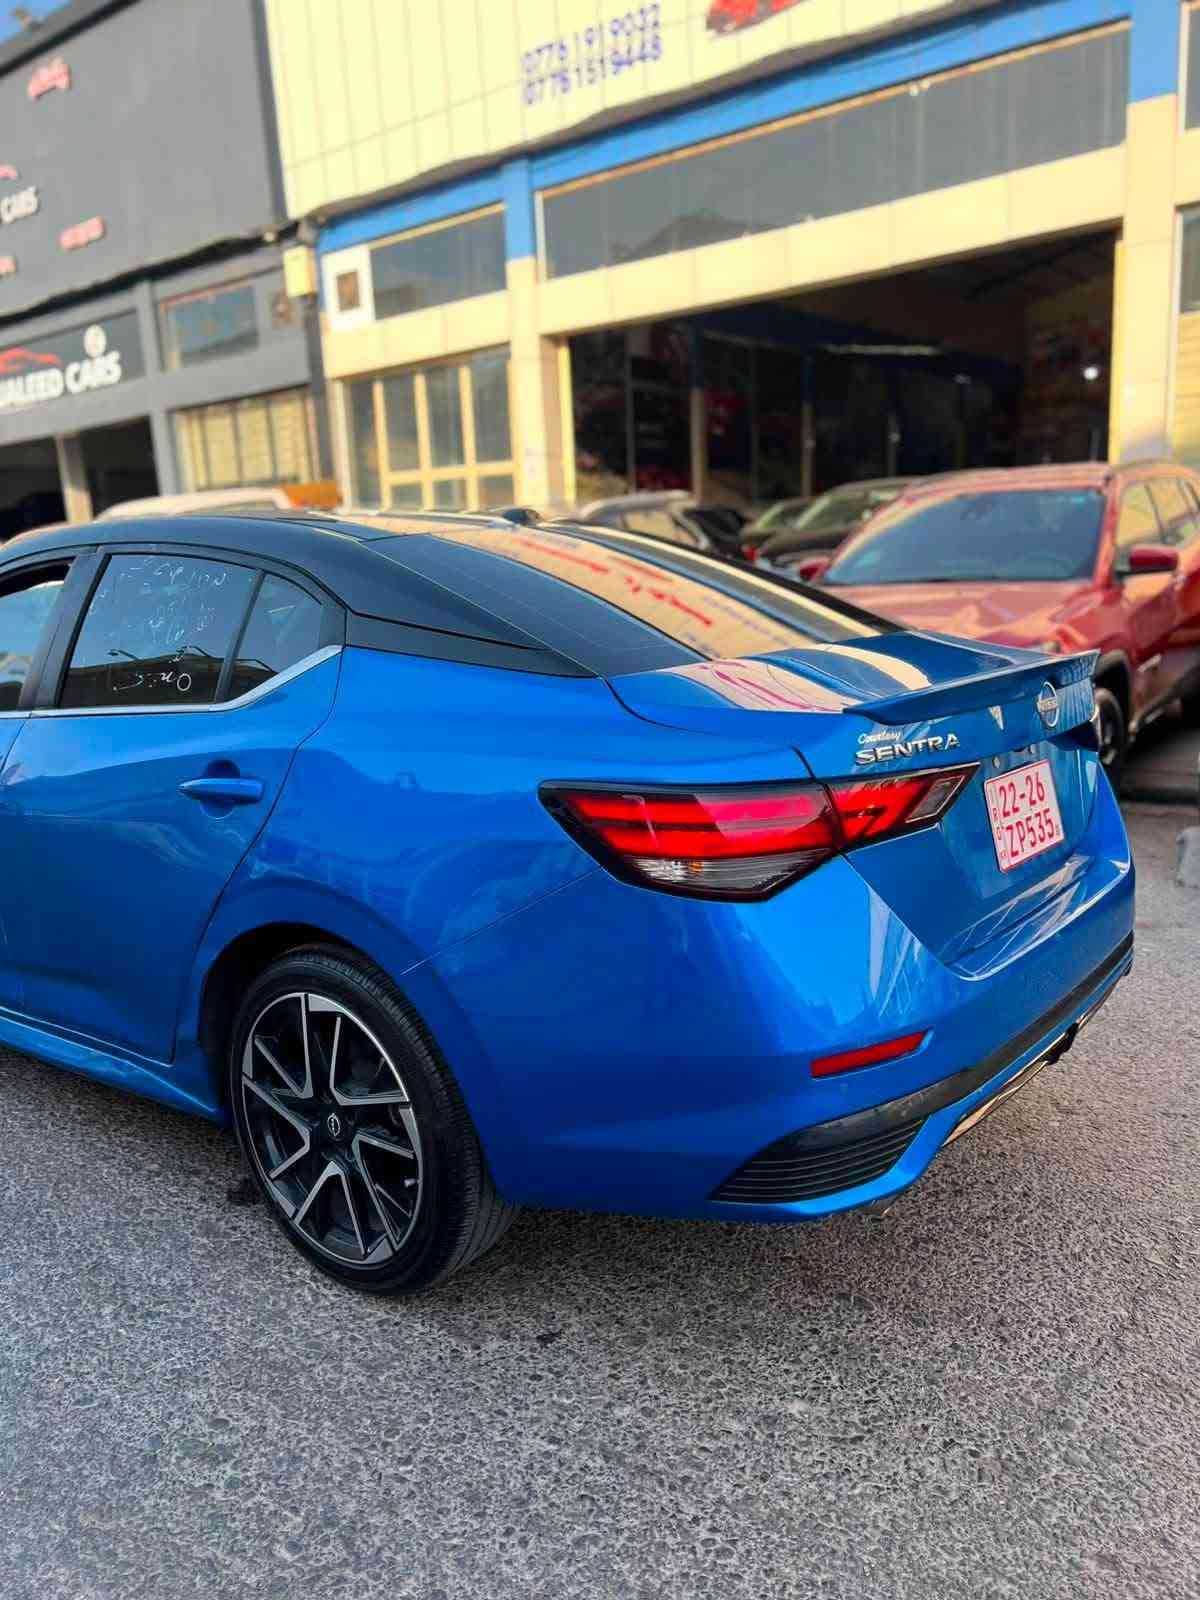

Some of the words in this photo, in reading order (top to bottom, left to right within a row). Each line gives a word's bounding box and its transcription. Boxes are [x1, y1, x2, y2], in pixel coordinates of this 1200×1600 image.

[65, 351, 121, 394] CARS
[855, 733, 960, 764] SENTRA
[999, 772, 1046, 817] 22-26
[1006, 808, 1055, 857] ZP535
